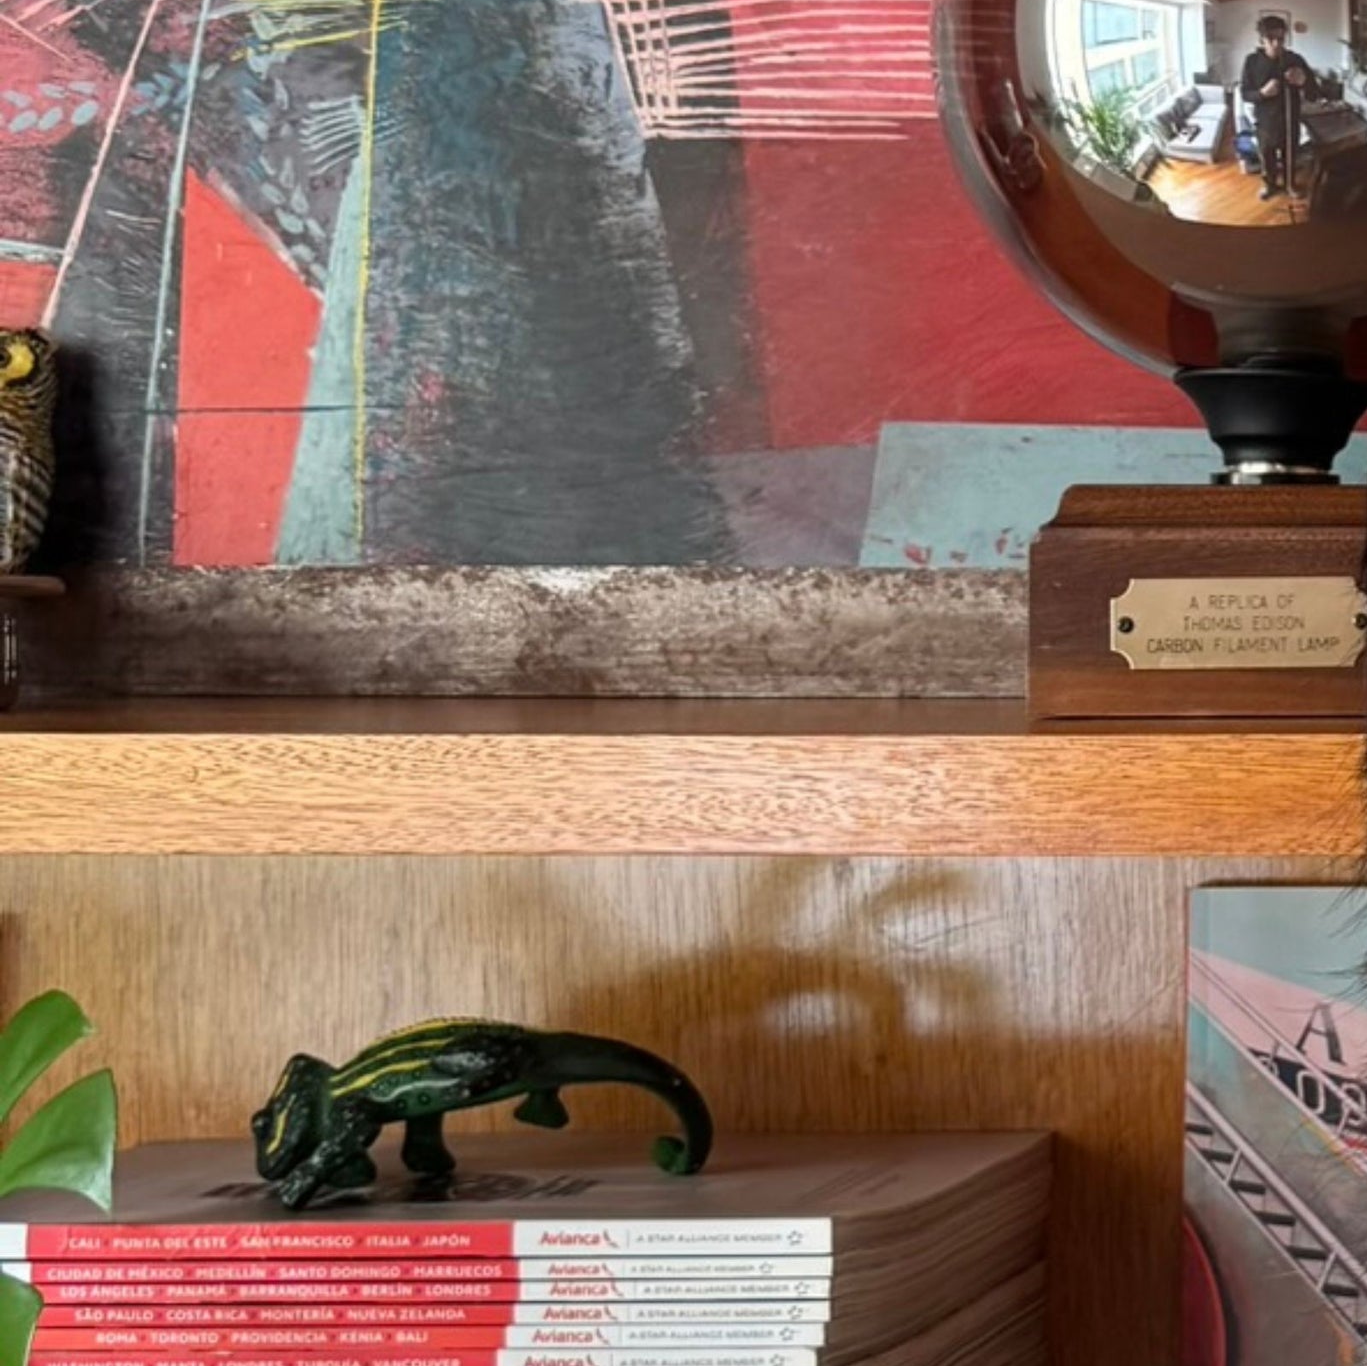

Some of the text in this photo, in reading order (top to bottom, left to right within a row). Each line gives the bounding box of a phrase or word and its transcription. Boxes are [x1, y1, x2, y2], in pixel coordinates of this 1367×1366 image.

[1190, 594, 1296, 610] A REPLICA OF
[1183, 615, 1305, 631] THOMAS EDISON
[1147, 637, 1341, 653] CARBON FILAMENT LAMP
[68, 1231, 600, 1249] CALI PUNTA DEL ESTE SAN FRANCISCO ITALIA JAPÓN Avianca
